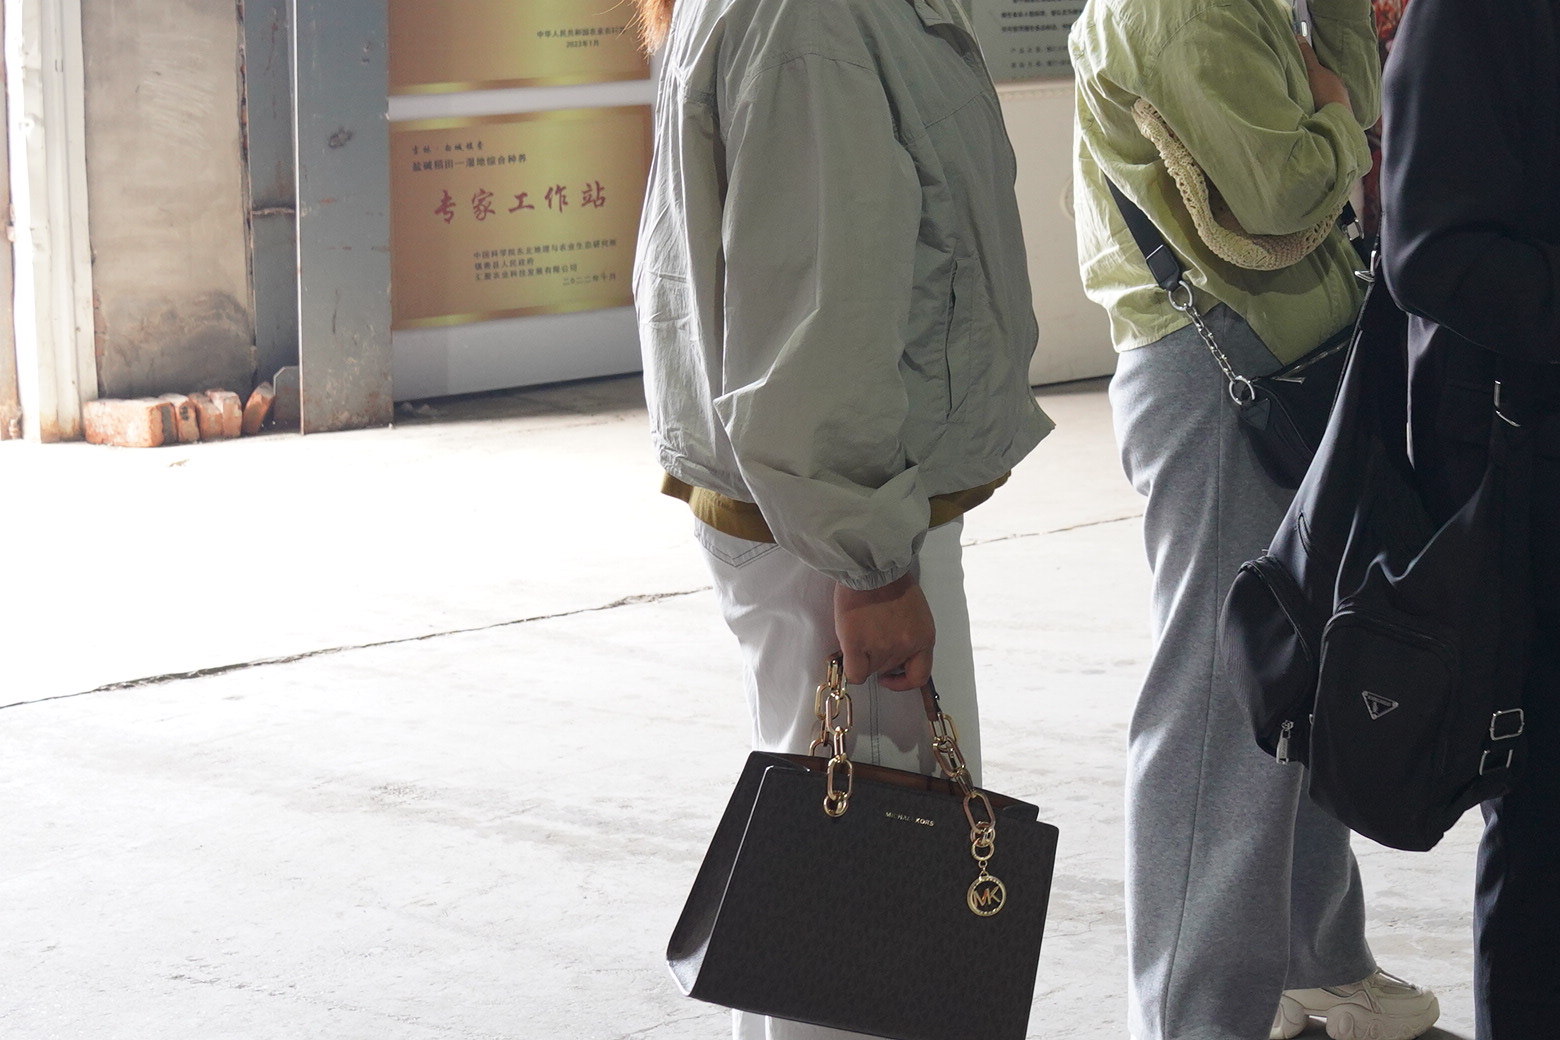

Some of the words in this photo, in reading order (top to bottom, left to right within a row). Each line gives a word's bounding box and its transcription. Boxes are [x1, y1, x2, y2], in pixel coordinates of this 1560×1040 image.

[434, 180, 607, 225] 专家工作站
